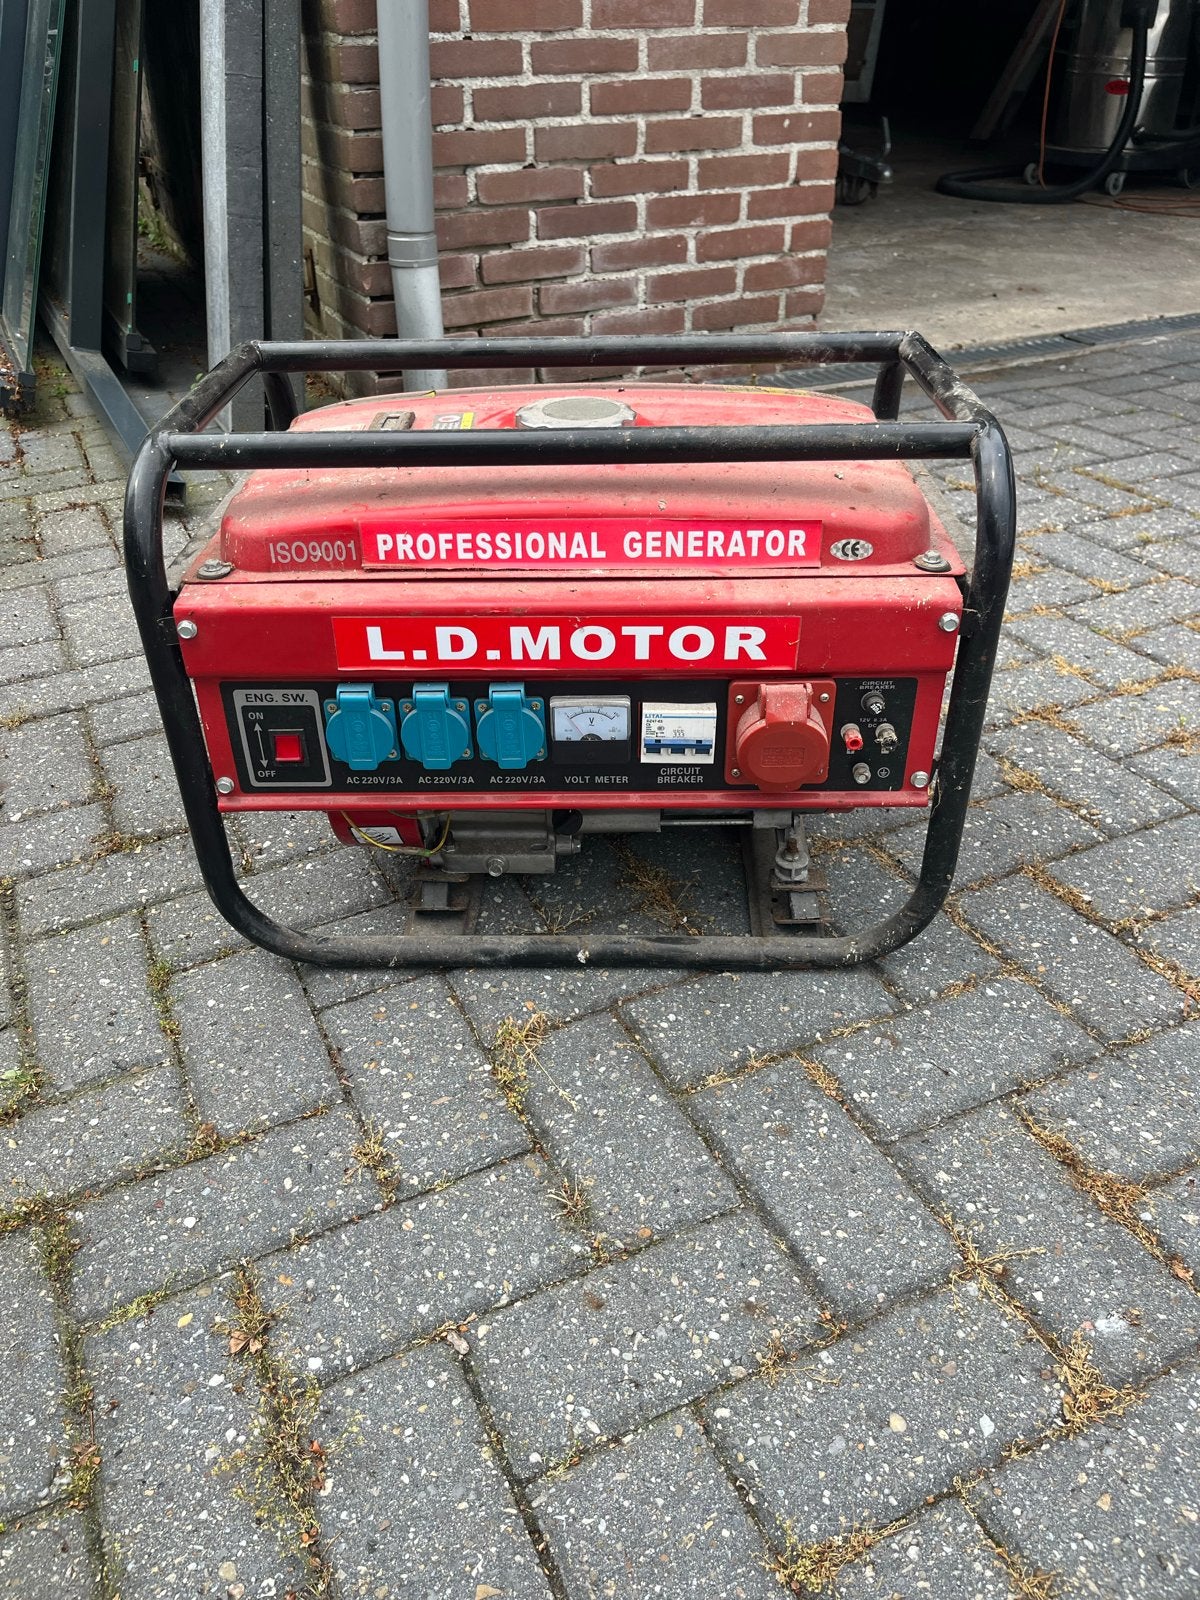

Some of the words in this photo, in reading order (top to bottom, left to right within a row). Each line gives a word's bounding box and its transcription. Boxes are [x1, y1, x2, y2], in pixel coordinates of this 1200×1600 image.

[376, 532, 605, 560] PROFESSIONAL
[622, 529, 807, 559] GENERATOR
[841, 541, 860, 557] CE
[269, 539, 357, 564] ISO9001
[365, 625, 768, 661] L.D.MOTOR
[248, 711, 264, 720] ON
[257, 770, 276, 778] OFF
[660, 767, 701, 775] CIRCUIT
[346, 776, 360, 784] AC
[361, 776, 403, 784] 220V/3A
[418, 776, 432, 784] AC
[433, 776, 475, 784] 220V/3A
[489, 776, 503, 784] AC
[505, 776, 546, 784] 220V/3A
[564, 775, 591, 784] VOLT
[594, 775, 629, 784] METER
[657, 775, 704, 784] BREAKER
